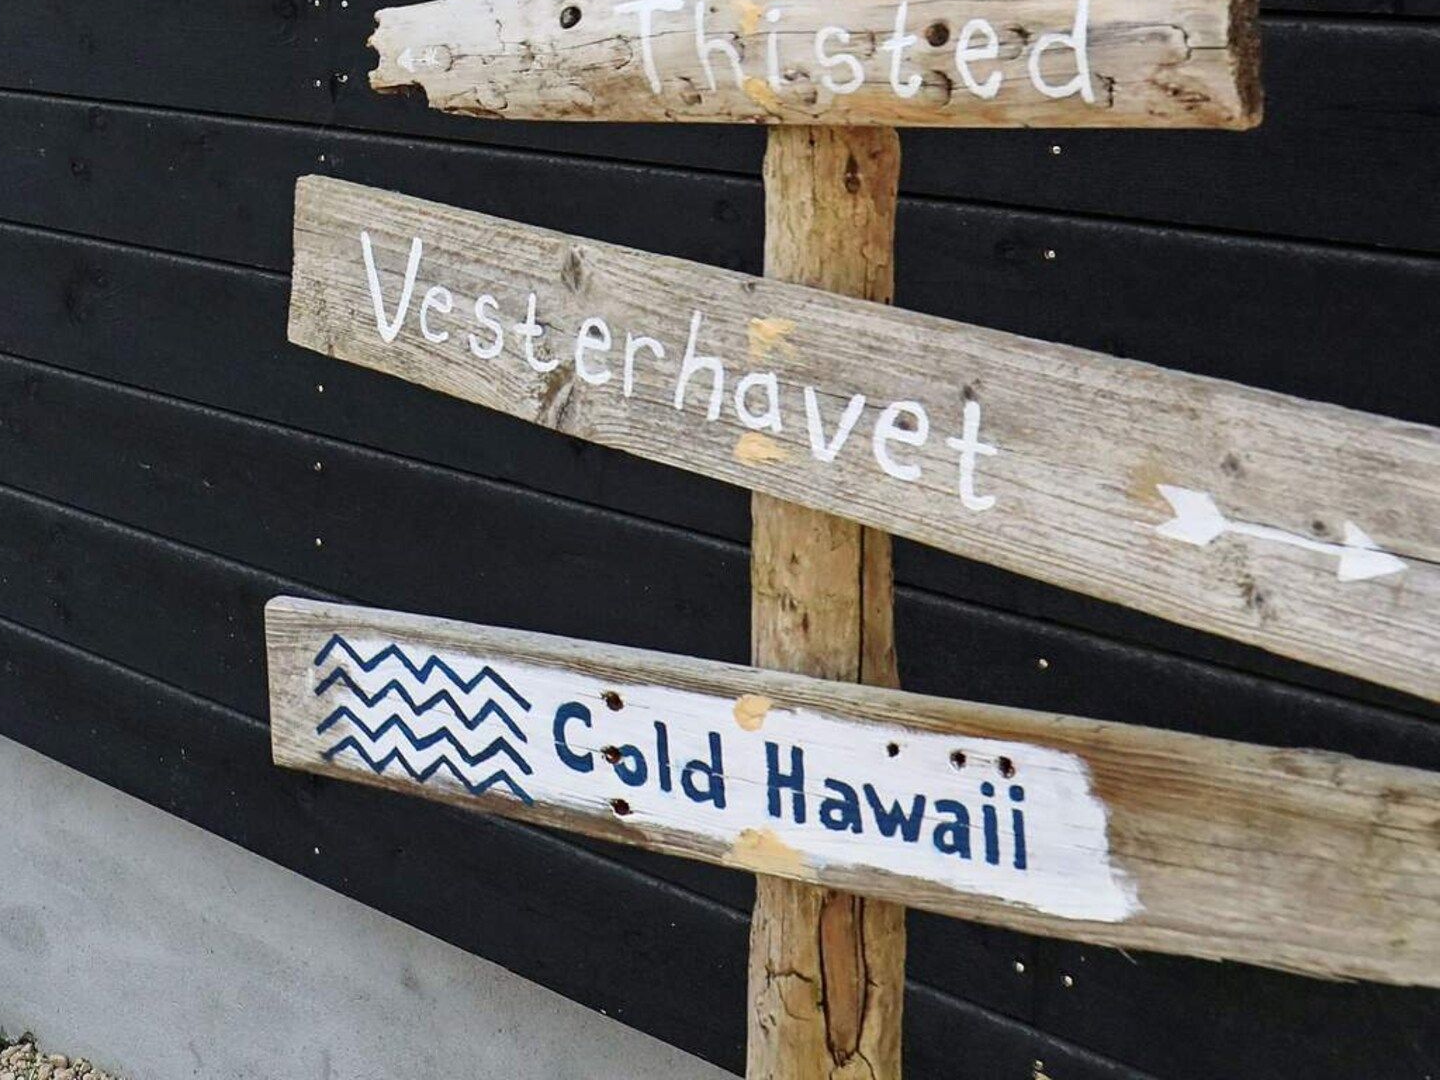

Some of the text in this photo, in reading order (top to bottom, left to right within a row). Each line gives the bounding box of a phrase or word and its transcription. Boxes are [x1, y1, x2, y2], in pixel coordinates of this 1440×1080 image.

[361, 231, 997, 511] Vesterhavet
[552, 701, 1028, 871] Cold Hawaii
